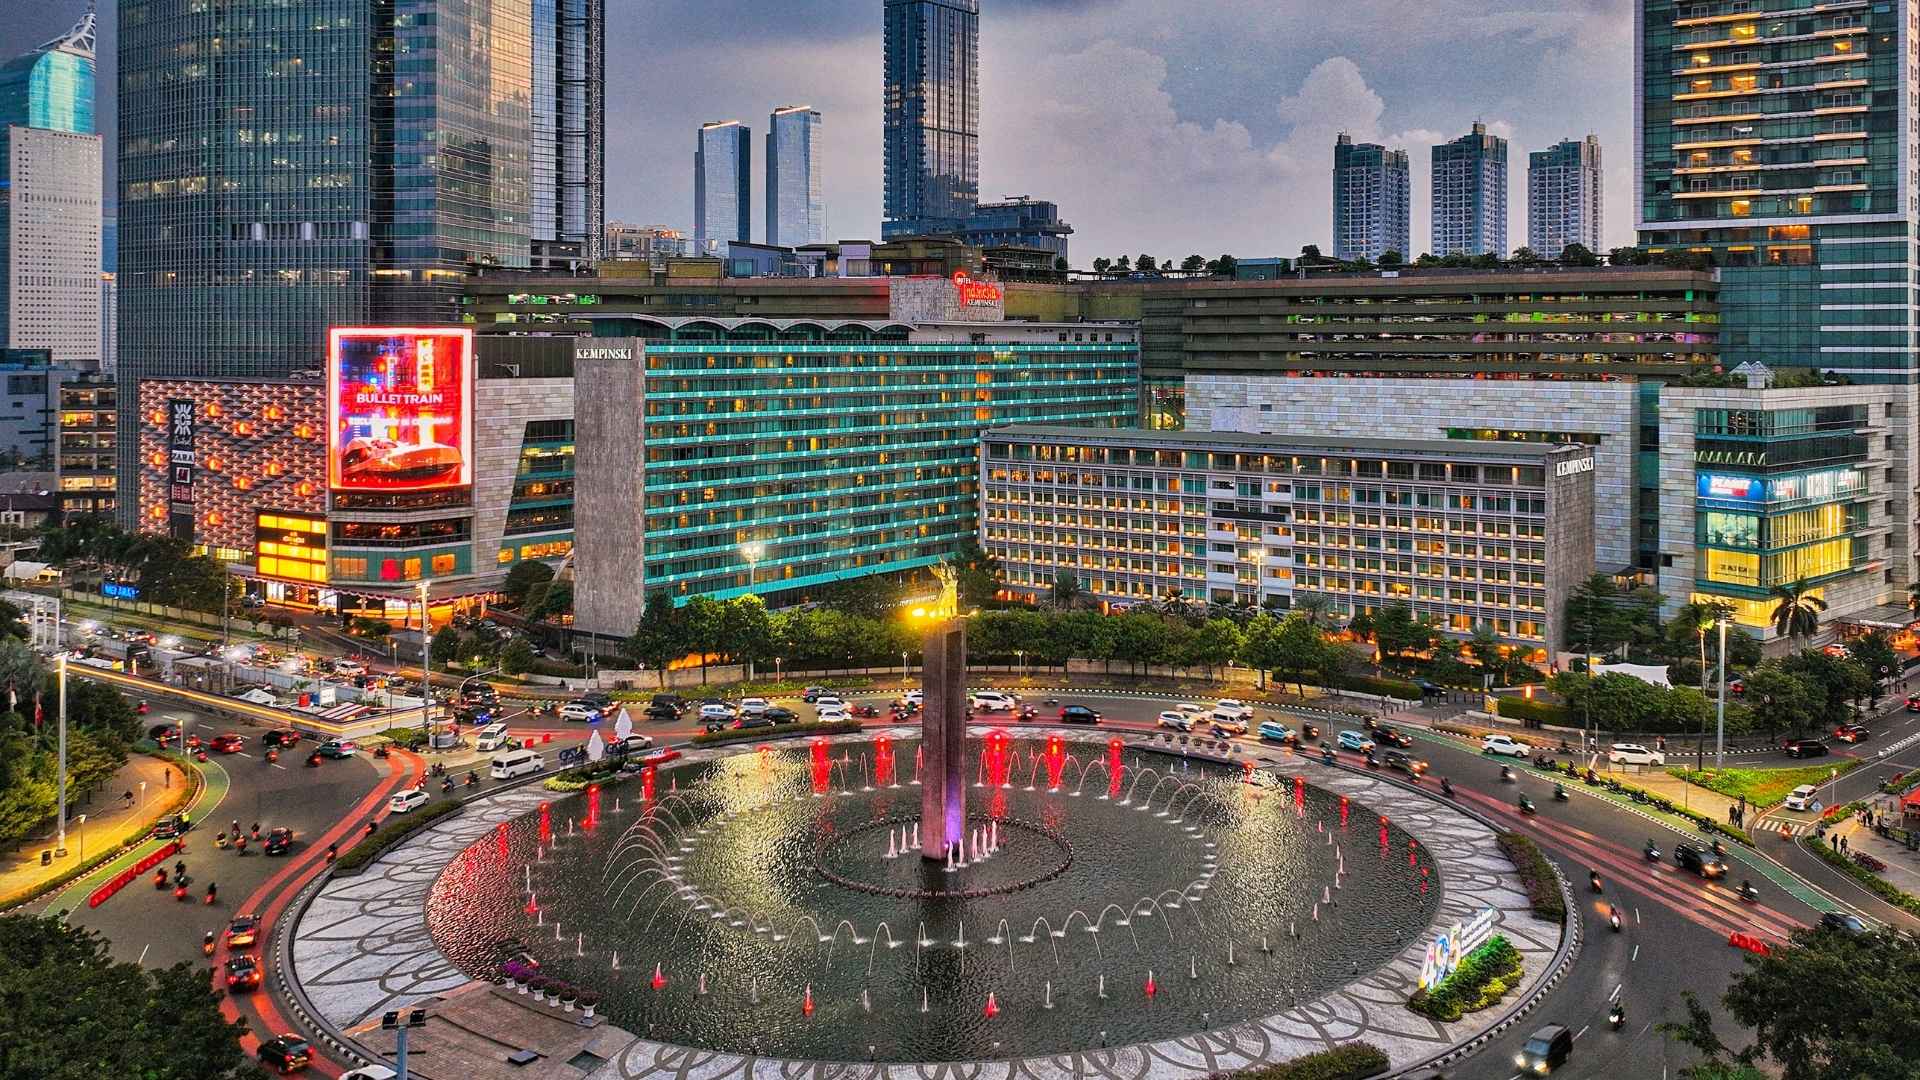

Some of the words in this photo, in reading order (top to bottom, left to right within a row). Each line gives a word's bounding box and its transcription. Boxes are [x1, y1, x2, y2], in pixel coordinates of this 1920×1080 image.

[576, 348, 632, 360] KEMPINSKI
[356, 393, 403, 403] BULLET
[404, 393, 443, 403] TRAIN
[171, 453, 193, 462] ZARA
[1556, 456, 1594, 477] KEMPINSKI
